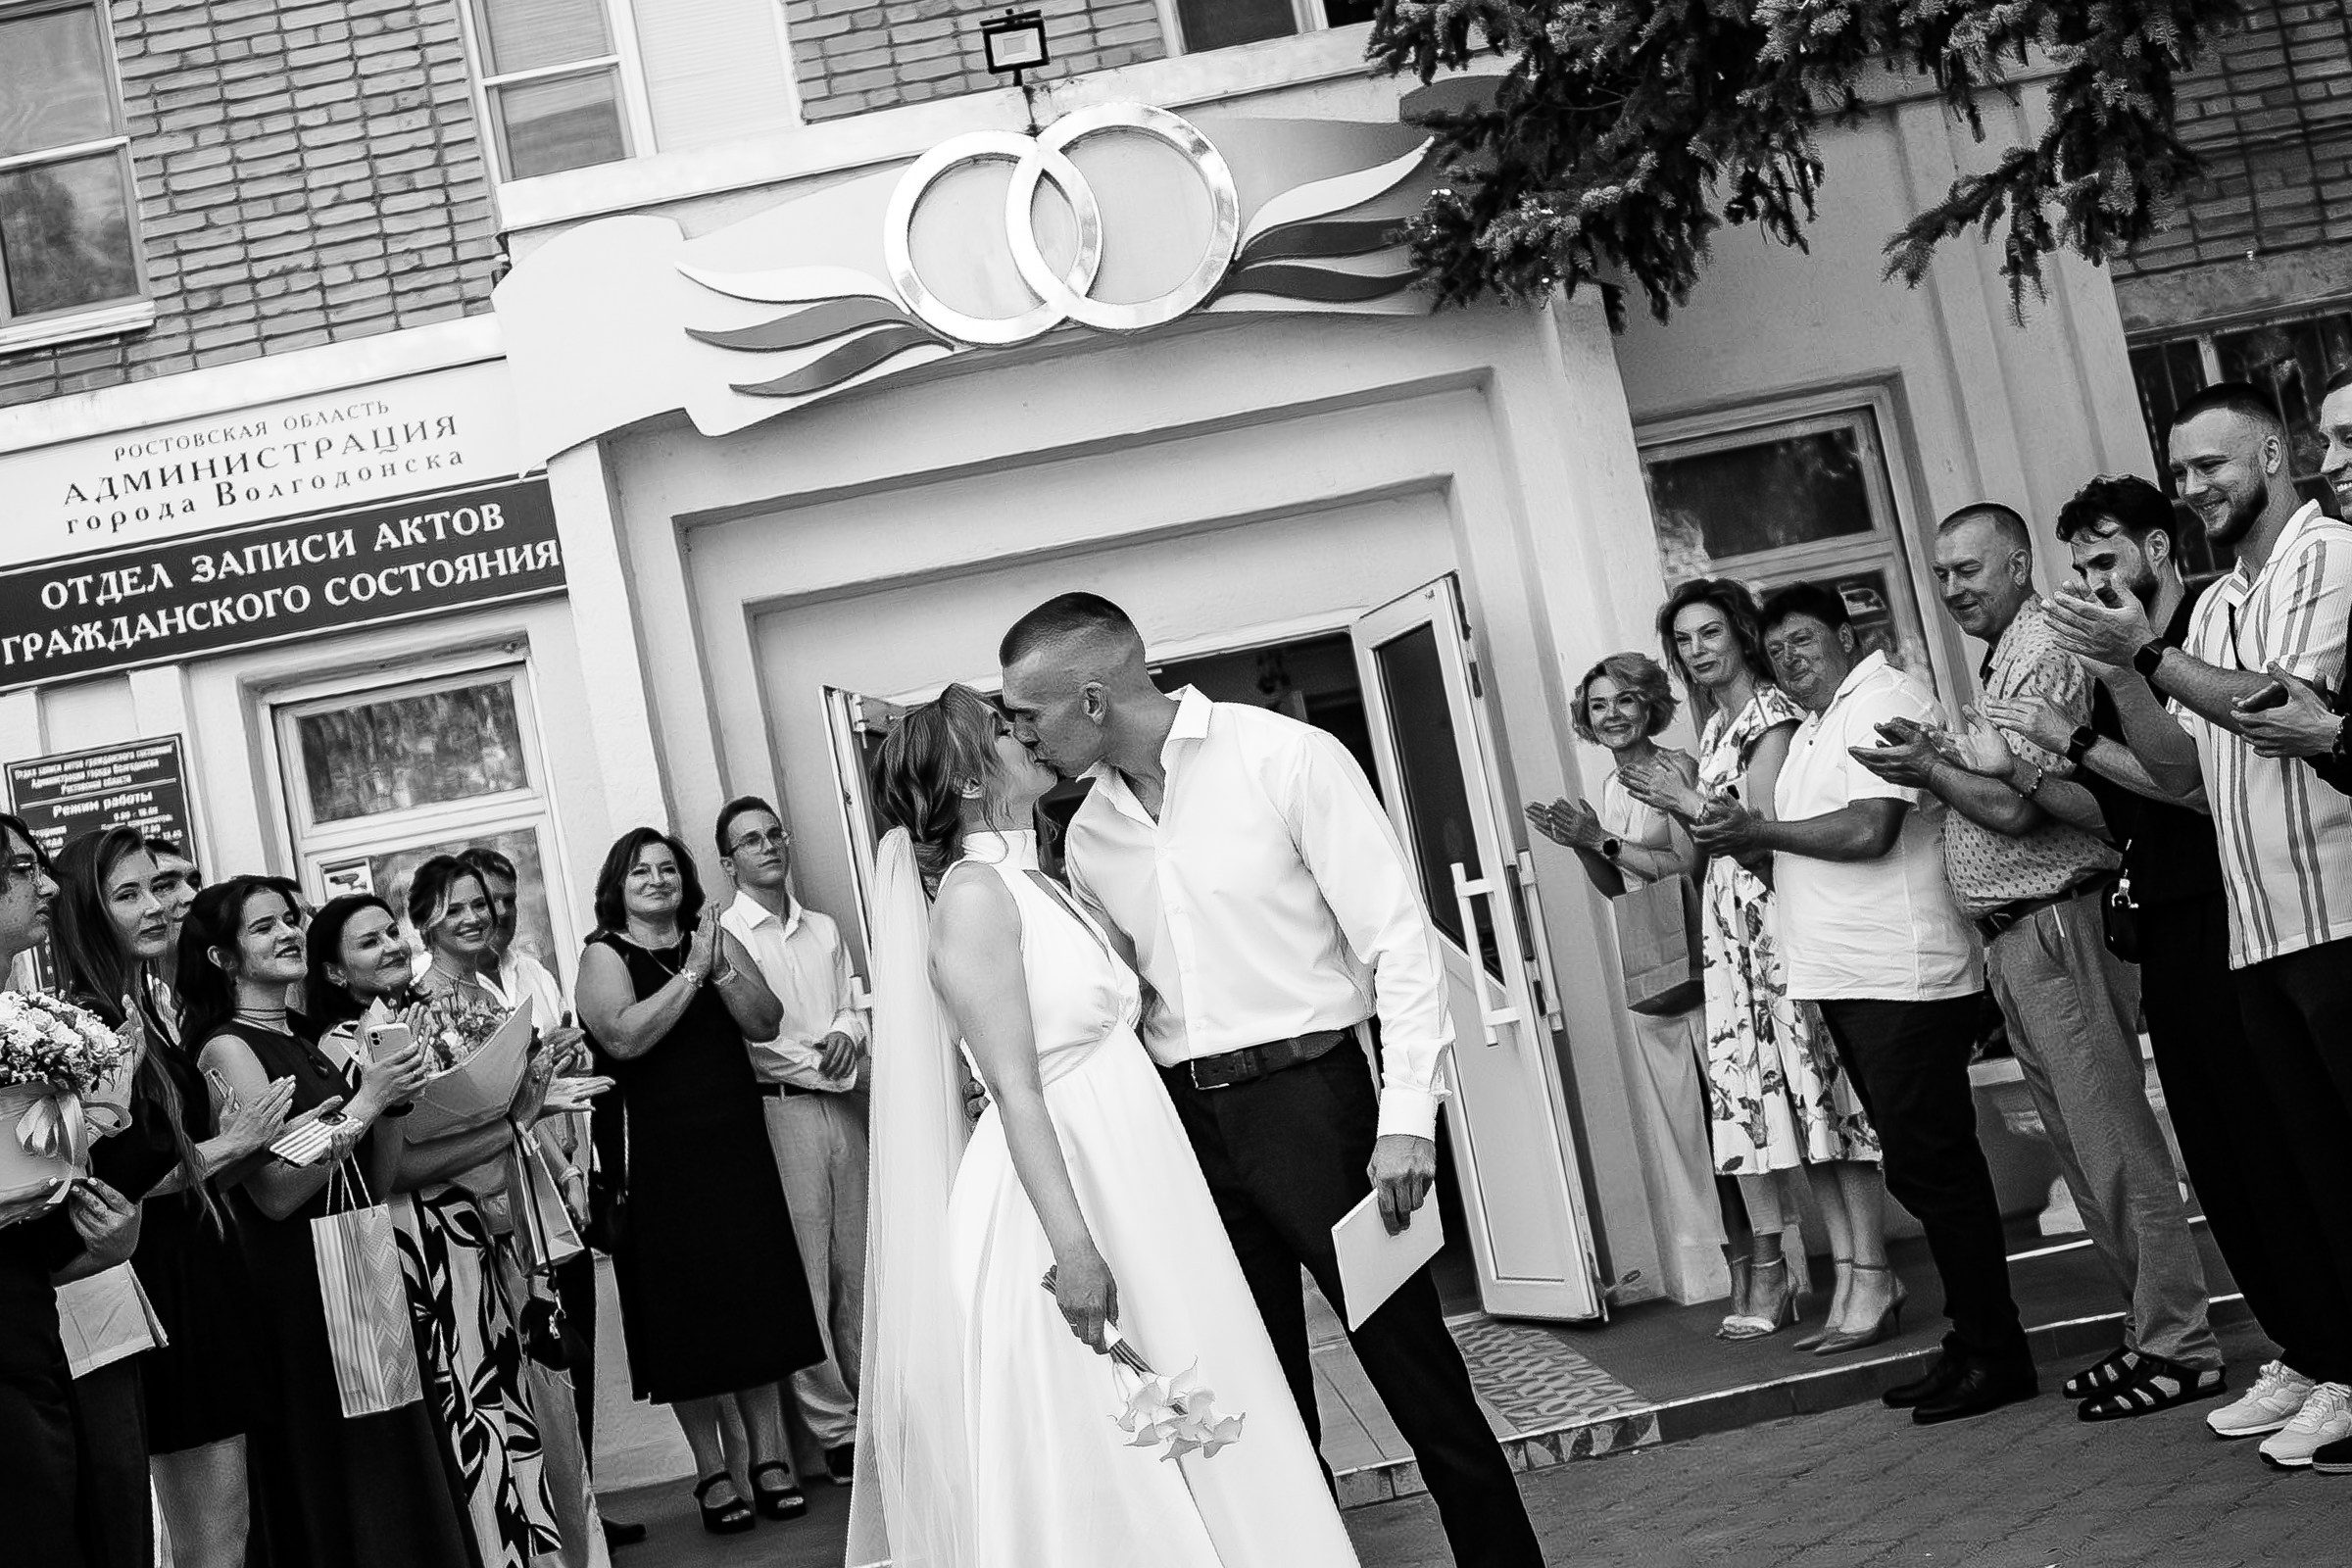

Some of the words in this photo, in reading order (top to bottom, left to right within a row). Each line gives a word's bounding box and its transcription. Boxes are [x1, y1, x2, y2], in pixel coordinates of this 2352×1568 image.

[63, 415, 458, 505] АДМИНИСТРАЦИЯ
[114, 420, 268, 462] РОСТОВСКАЯ
[283, 400, 390, 430] ОБЛАСТЬ
[68, 496, 196, 533] города
[217, 450, 465, 508] Волгодонска
[40, 562, 174, 611] ОТДЕЛ
[190, 528, 358, 584] ЗАПИСИ
[373, 501, 506, 552] АКТОВ
[1, 583, 312, 665] ГРАЖДАНСКОГО
[324, 538, 561, 608] СОСТОЯНИЯ
[53, 801, 99, 818] Режим
[103, 791, 153, 811] работы
